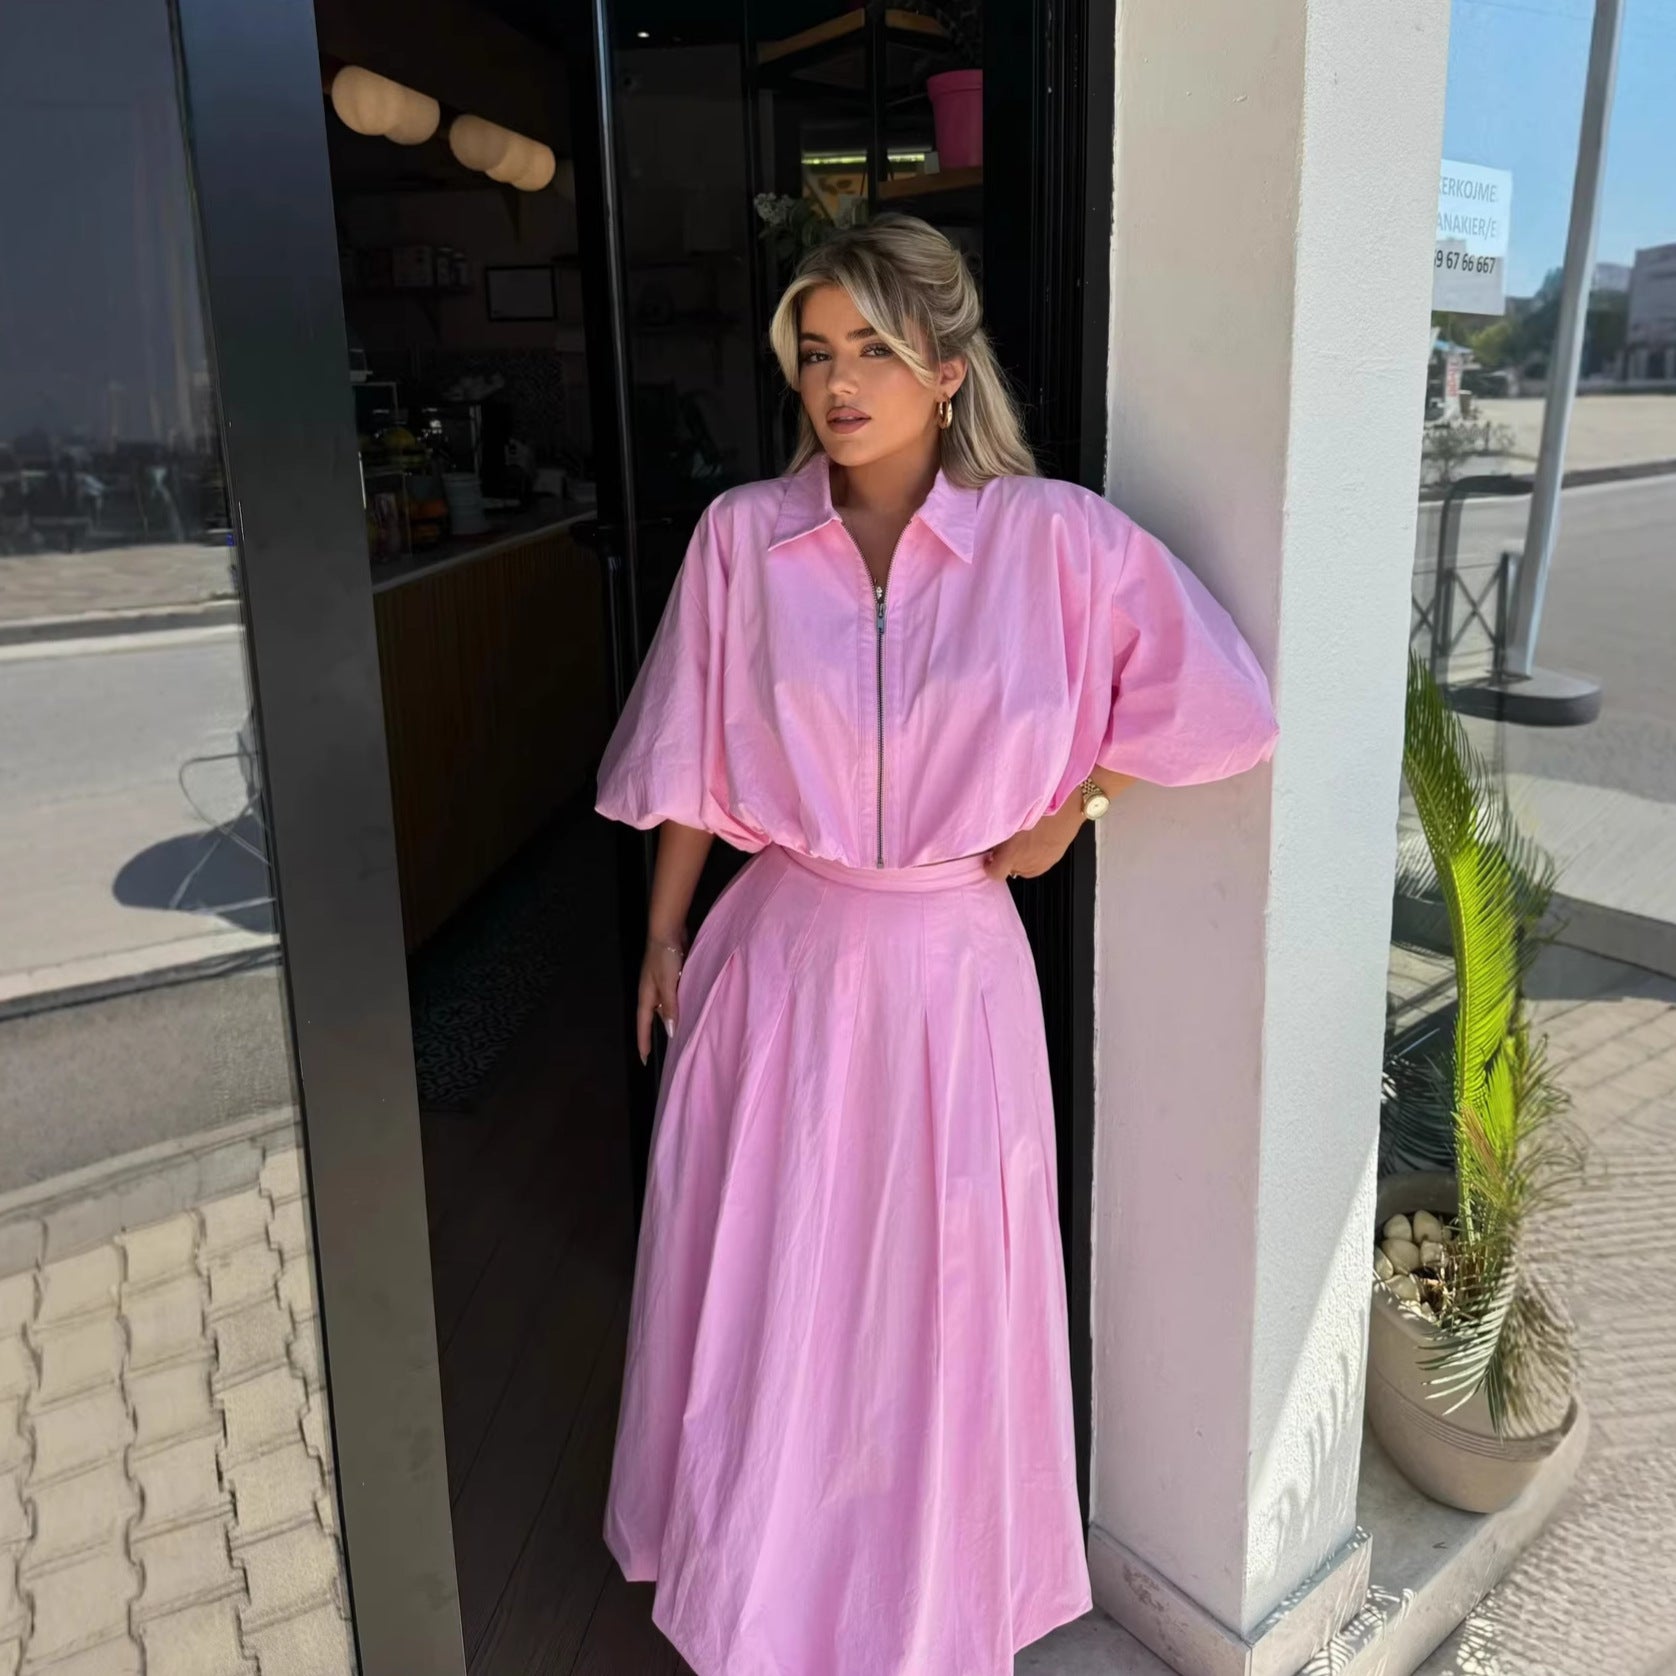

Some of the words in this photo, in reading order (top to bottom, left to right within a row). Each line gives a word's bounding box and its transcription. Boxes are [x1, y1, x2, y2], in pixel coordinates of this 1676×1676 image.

[1439, 176, 1497, 202] ERKOJME
[1434, 249, 1444, 268] 9
[1446, 251, 1460, 270] 67
[1462, 253, 1475, 271] 66
[1476, 255, 1496, 274] 667
